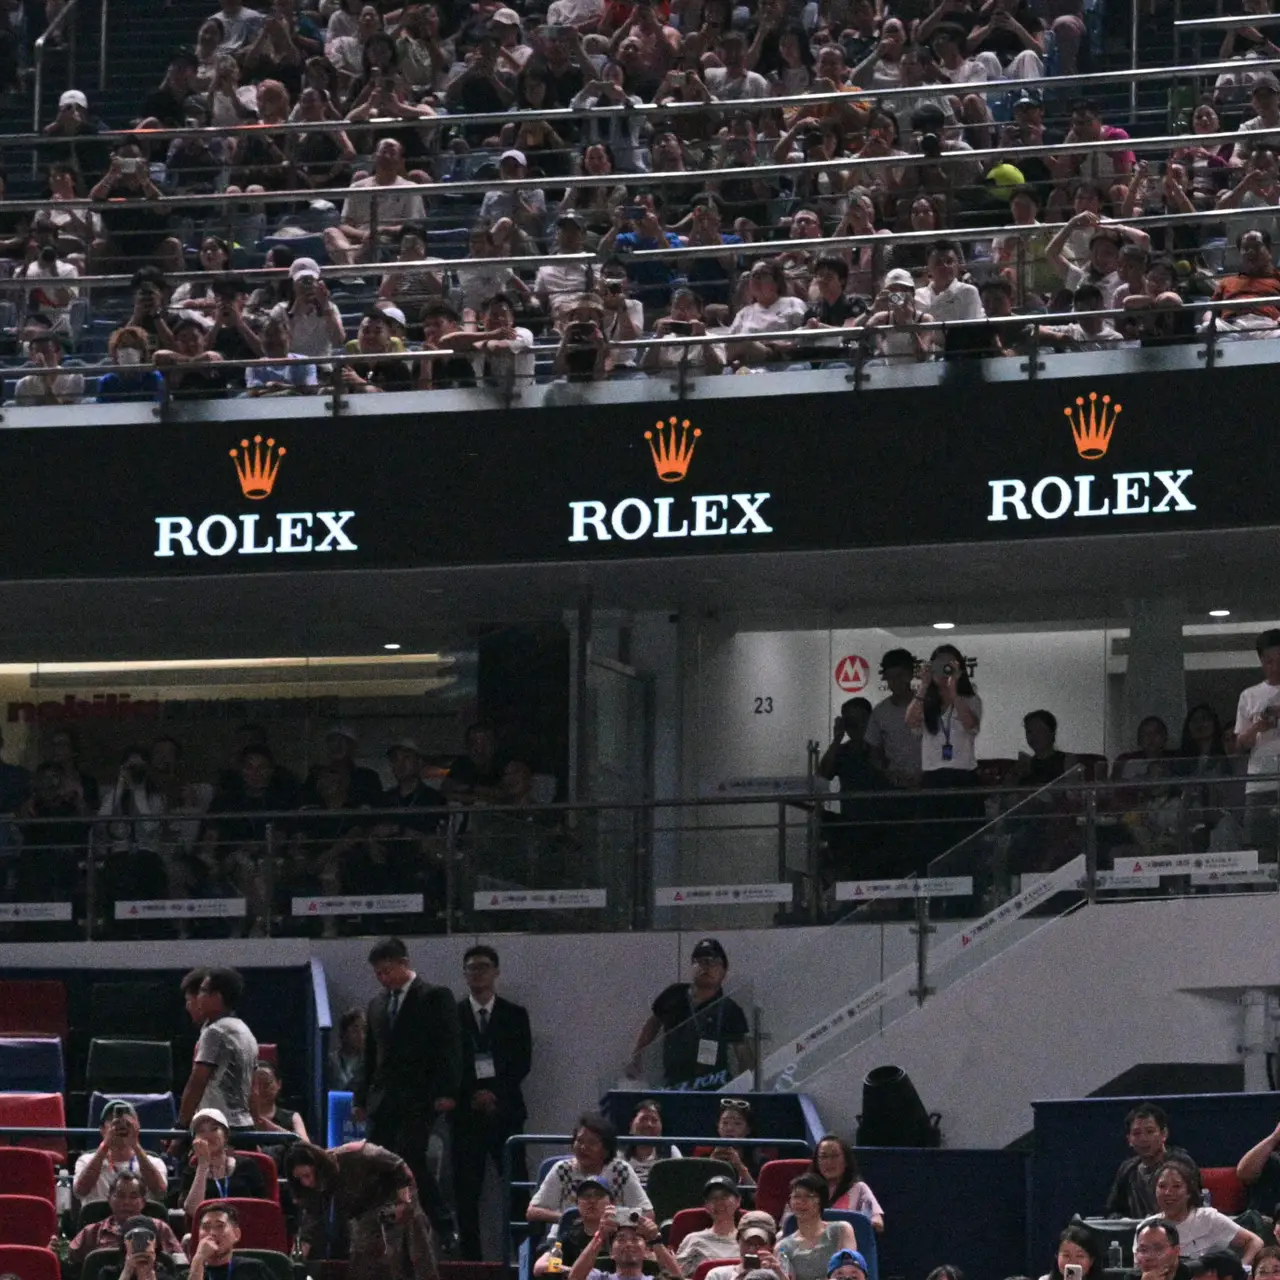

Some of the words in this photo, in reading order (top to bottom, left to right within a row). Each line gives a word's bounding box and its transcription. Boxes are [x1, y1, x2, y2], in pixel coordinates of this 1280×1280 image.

[568, 493, 773, 541] ROLEX
[988, 470, 1196, 521] ROLEX
[154, 511, 357, 556] ROLEX
[754, 696, 774, 714] 23
